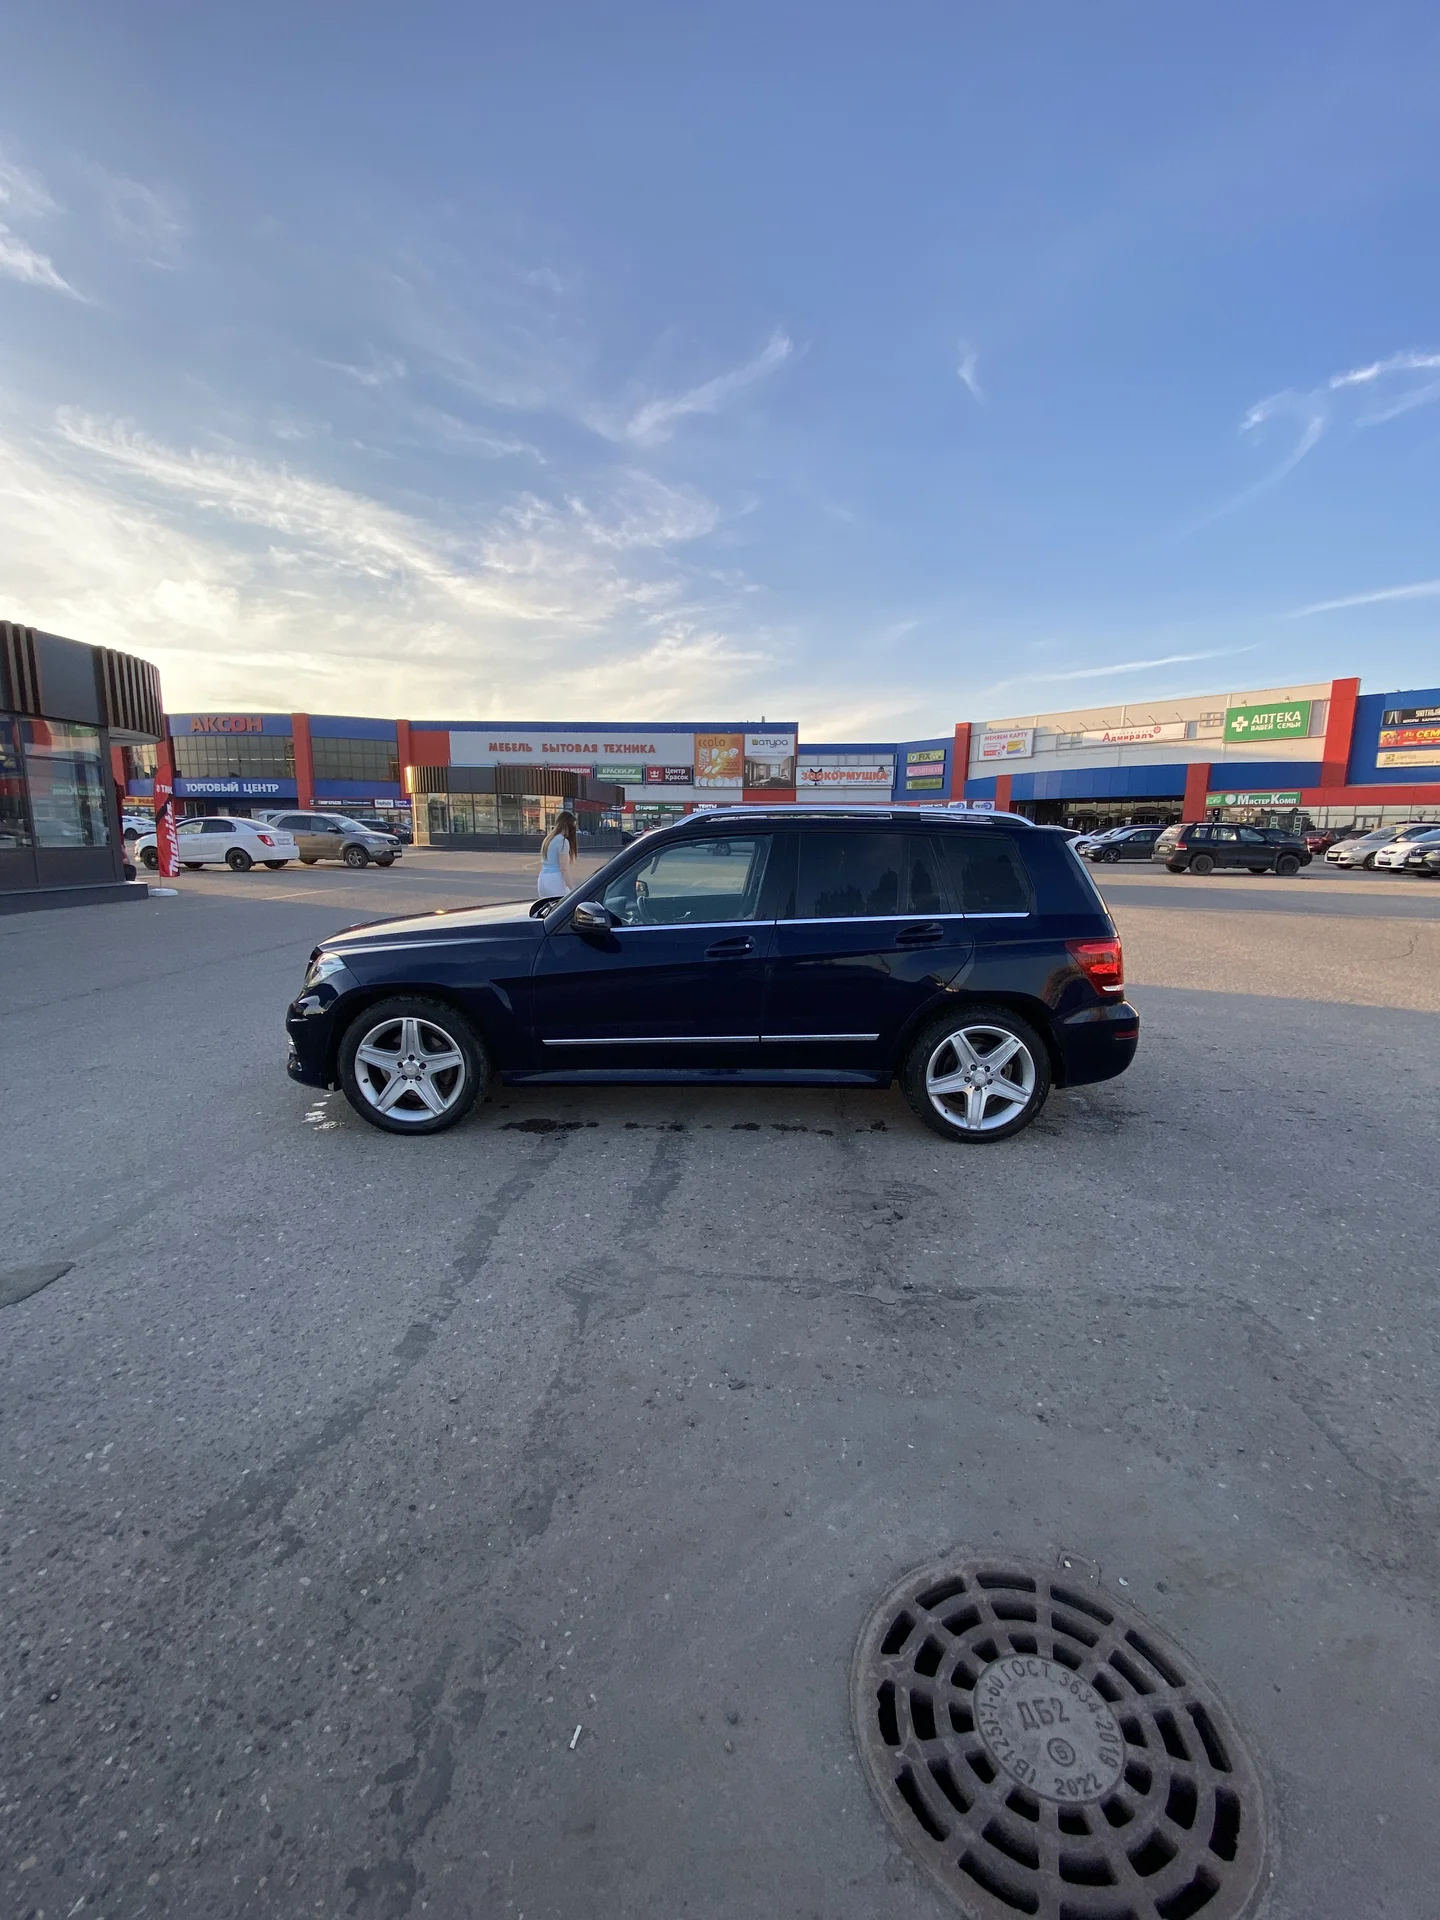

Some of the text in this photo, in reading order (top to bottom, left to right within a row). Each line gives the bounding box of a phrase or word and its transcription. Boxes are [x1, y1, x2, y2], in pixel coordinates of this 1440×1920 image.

[190, 716, 263, 732] АКСОН
[1251, 711, 1301, 724] АПТЕКА
[1009, 731, 1028, 739] КАРТУ
[1102, 732, 1153, 742] Адмиралъ
[488, 742, 656, 754] МЕБЕЛЬ БЫТОВАЯ ТЕХНИКА
[698, 737, 726, 747] ecola
[801, 771, 888, 781] ЗООКОРМУШКА
[186, 781, 239, 792] ТОРГОВЫЙ
[243, 783, 280, 794] ЦЕНТР
[1000, 1659, 1051, 1682] ГОСТ
[1016, 1697, 1070, 1731] ДБ2
[1054, 1772, 1103, 1796] 2022
